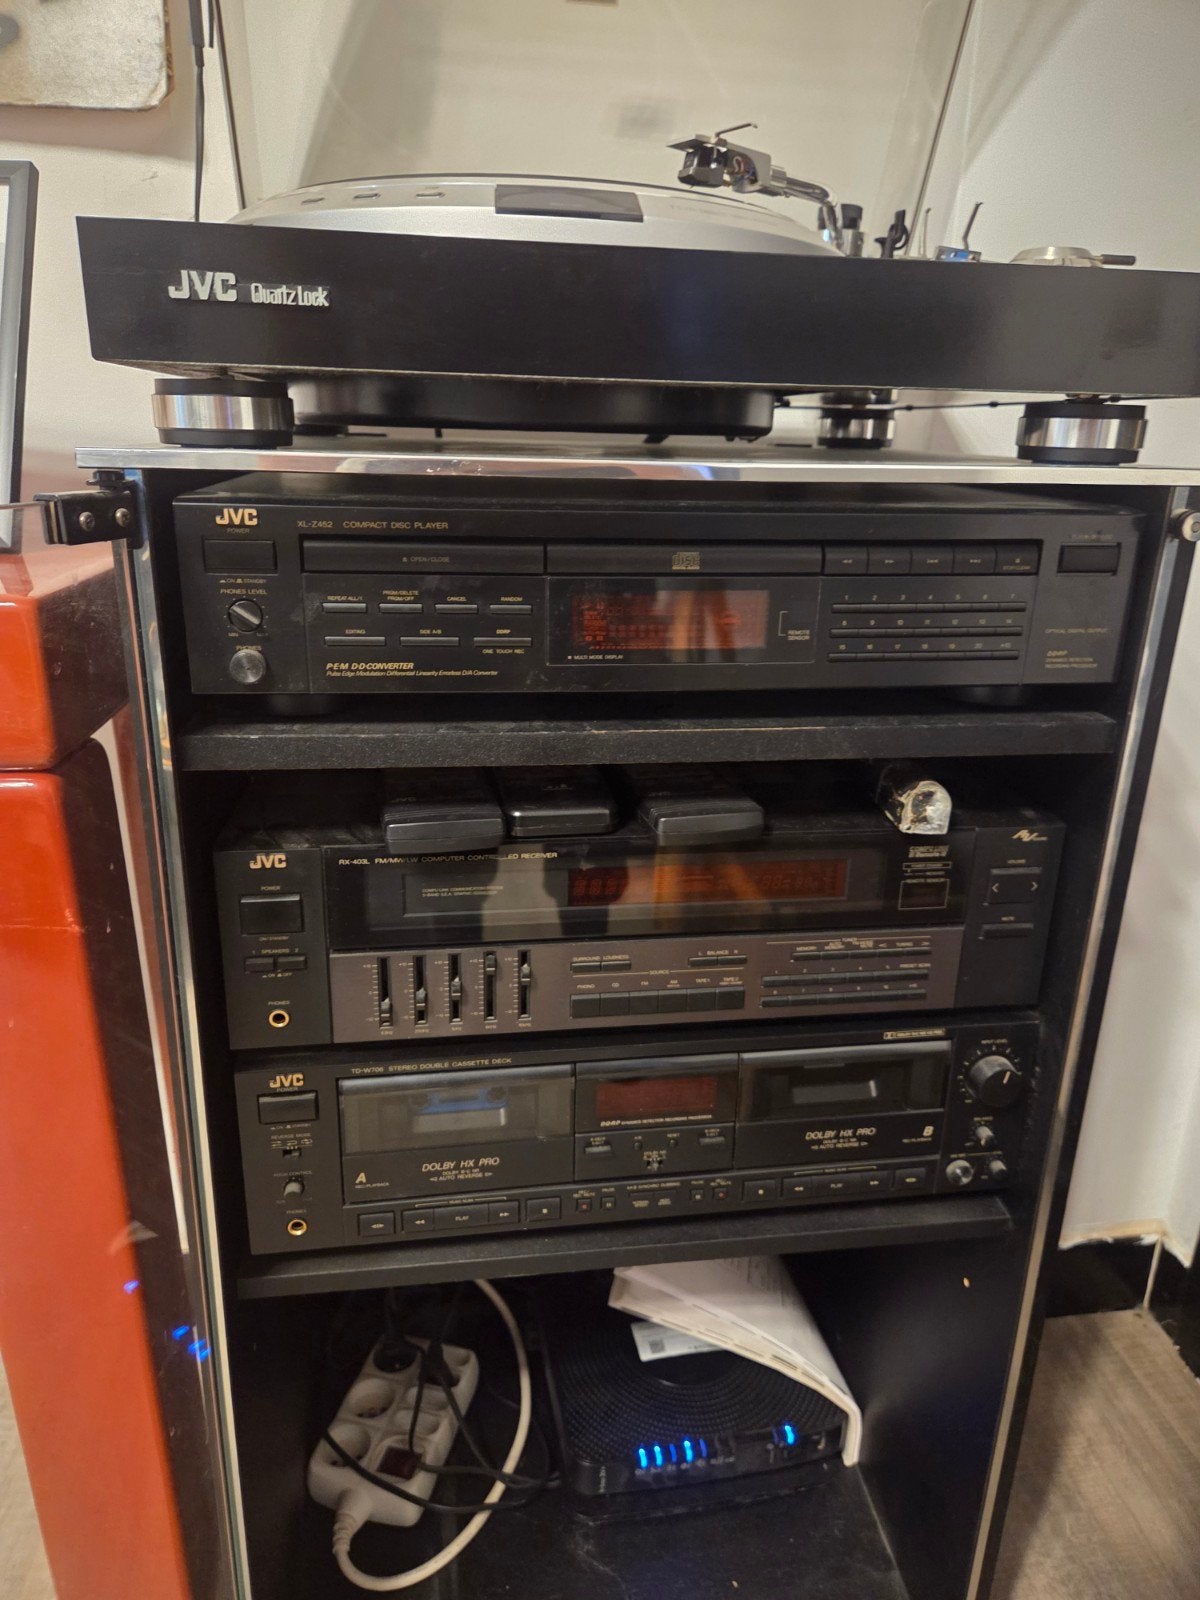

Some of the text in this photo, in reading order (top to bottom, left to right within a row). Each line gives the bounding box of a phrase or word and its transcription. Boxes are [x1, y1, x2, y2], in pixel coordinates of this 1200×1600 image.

[167, 269, 330, 307] JVC Quartz Lock
[215, 508, 259, 526] JVC
[296, 519, 449, 530] XL-Z452 COMPACT DISC PLAYER
[249, 853, 288, 869] JVC
[338, 858, 370, 866] RX-403L
[375, 857, 418, 865] FM/MW/LW
[421, 854, 466, 863] COMPUTER
[520, 851, 558, 860] RECEIVER
[261, 947, 290, 955] SPEAKERS
[351, 1057, 513, 1075] TD-W706 STEREO DOUBLE CASSETTE DECK
[269, 1073, 304, 1089] JVC
[805, 1129, 837, 1141] DOLBY
[839, 1128, 854, 1138] HX
[855, 1127, 877, 1136] PRO
[922, 1125, 935, 1137] B
[421, 1160, 457, 1173] DOLBY
[460, 1159, 476, 1169] HX
[479, 1156, 501, 1167] PRO
[355, 1171, 367, 1185] A
[457, 1172, 484, 1180] REVERSE
[455, 1214, 470, 1222] PLAY
